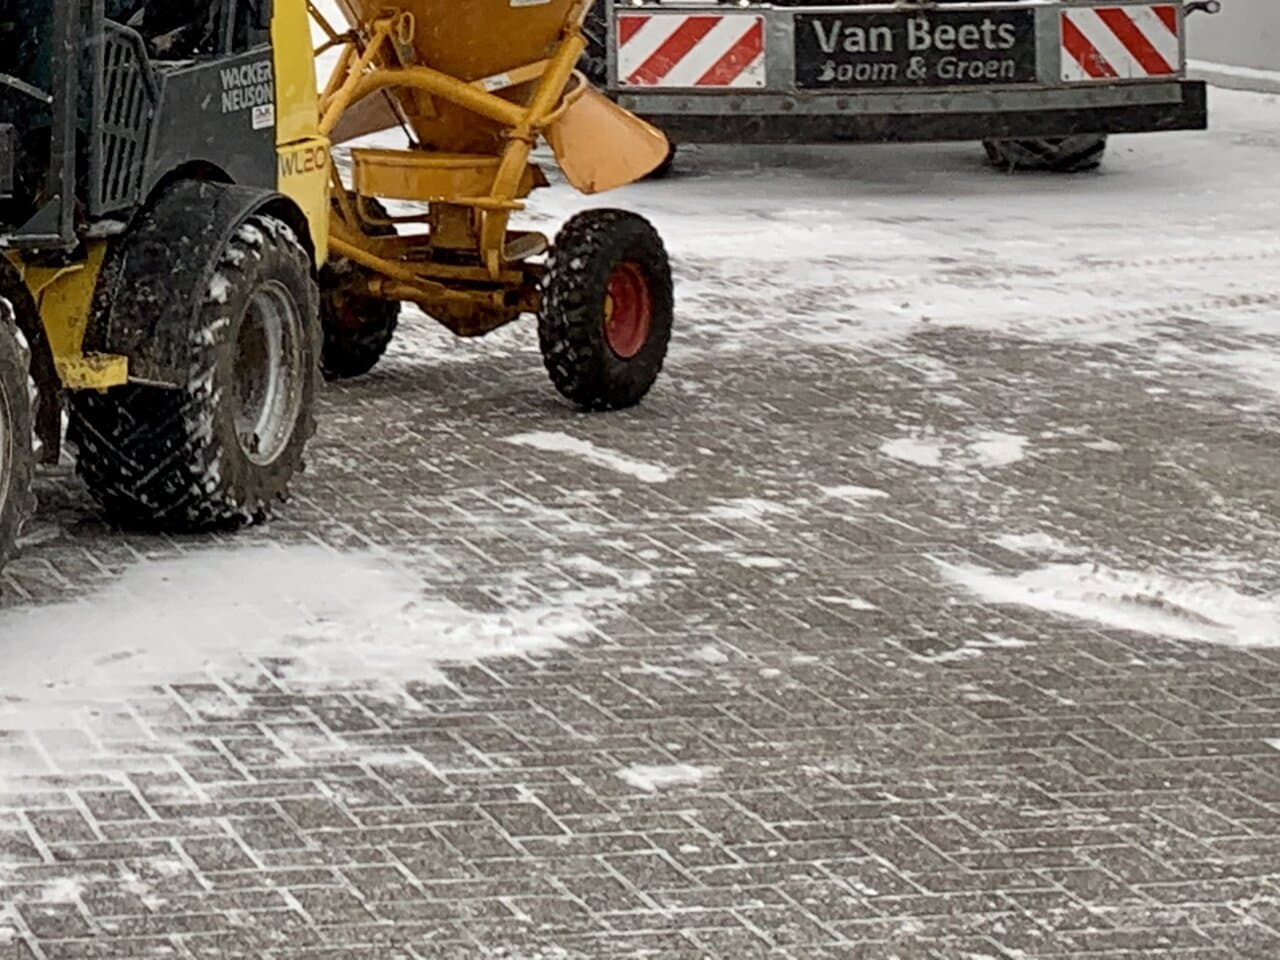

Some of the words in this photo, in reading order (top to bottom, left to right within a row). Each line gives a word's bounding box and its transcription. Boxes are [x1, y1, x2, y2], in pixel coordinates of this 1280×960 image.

[812, 19, 893, 53] Van
[906, 18, 1016, 51] Beets
[220, 60, 273, 90] WACKER
[906, 56, 927, 80] &
[937, 56, 1015, 79] Groen
[221, 82, 274, 113] NEUSON
[279, 145, 326, 177] WL20
